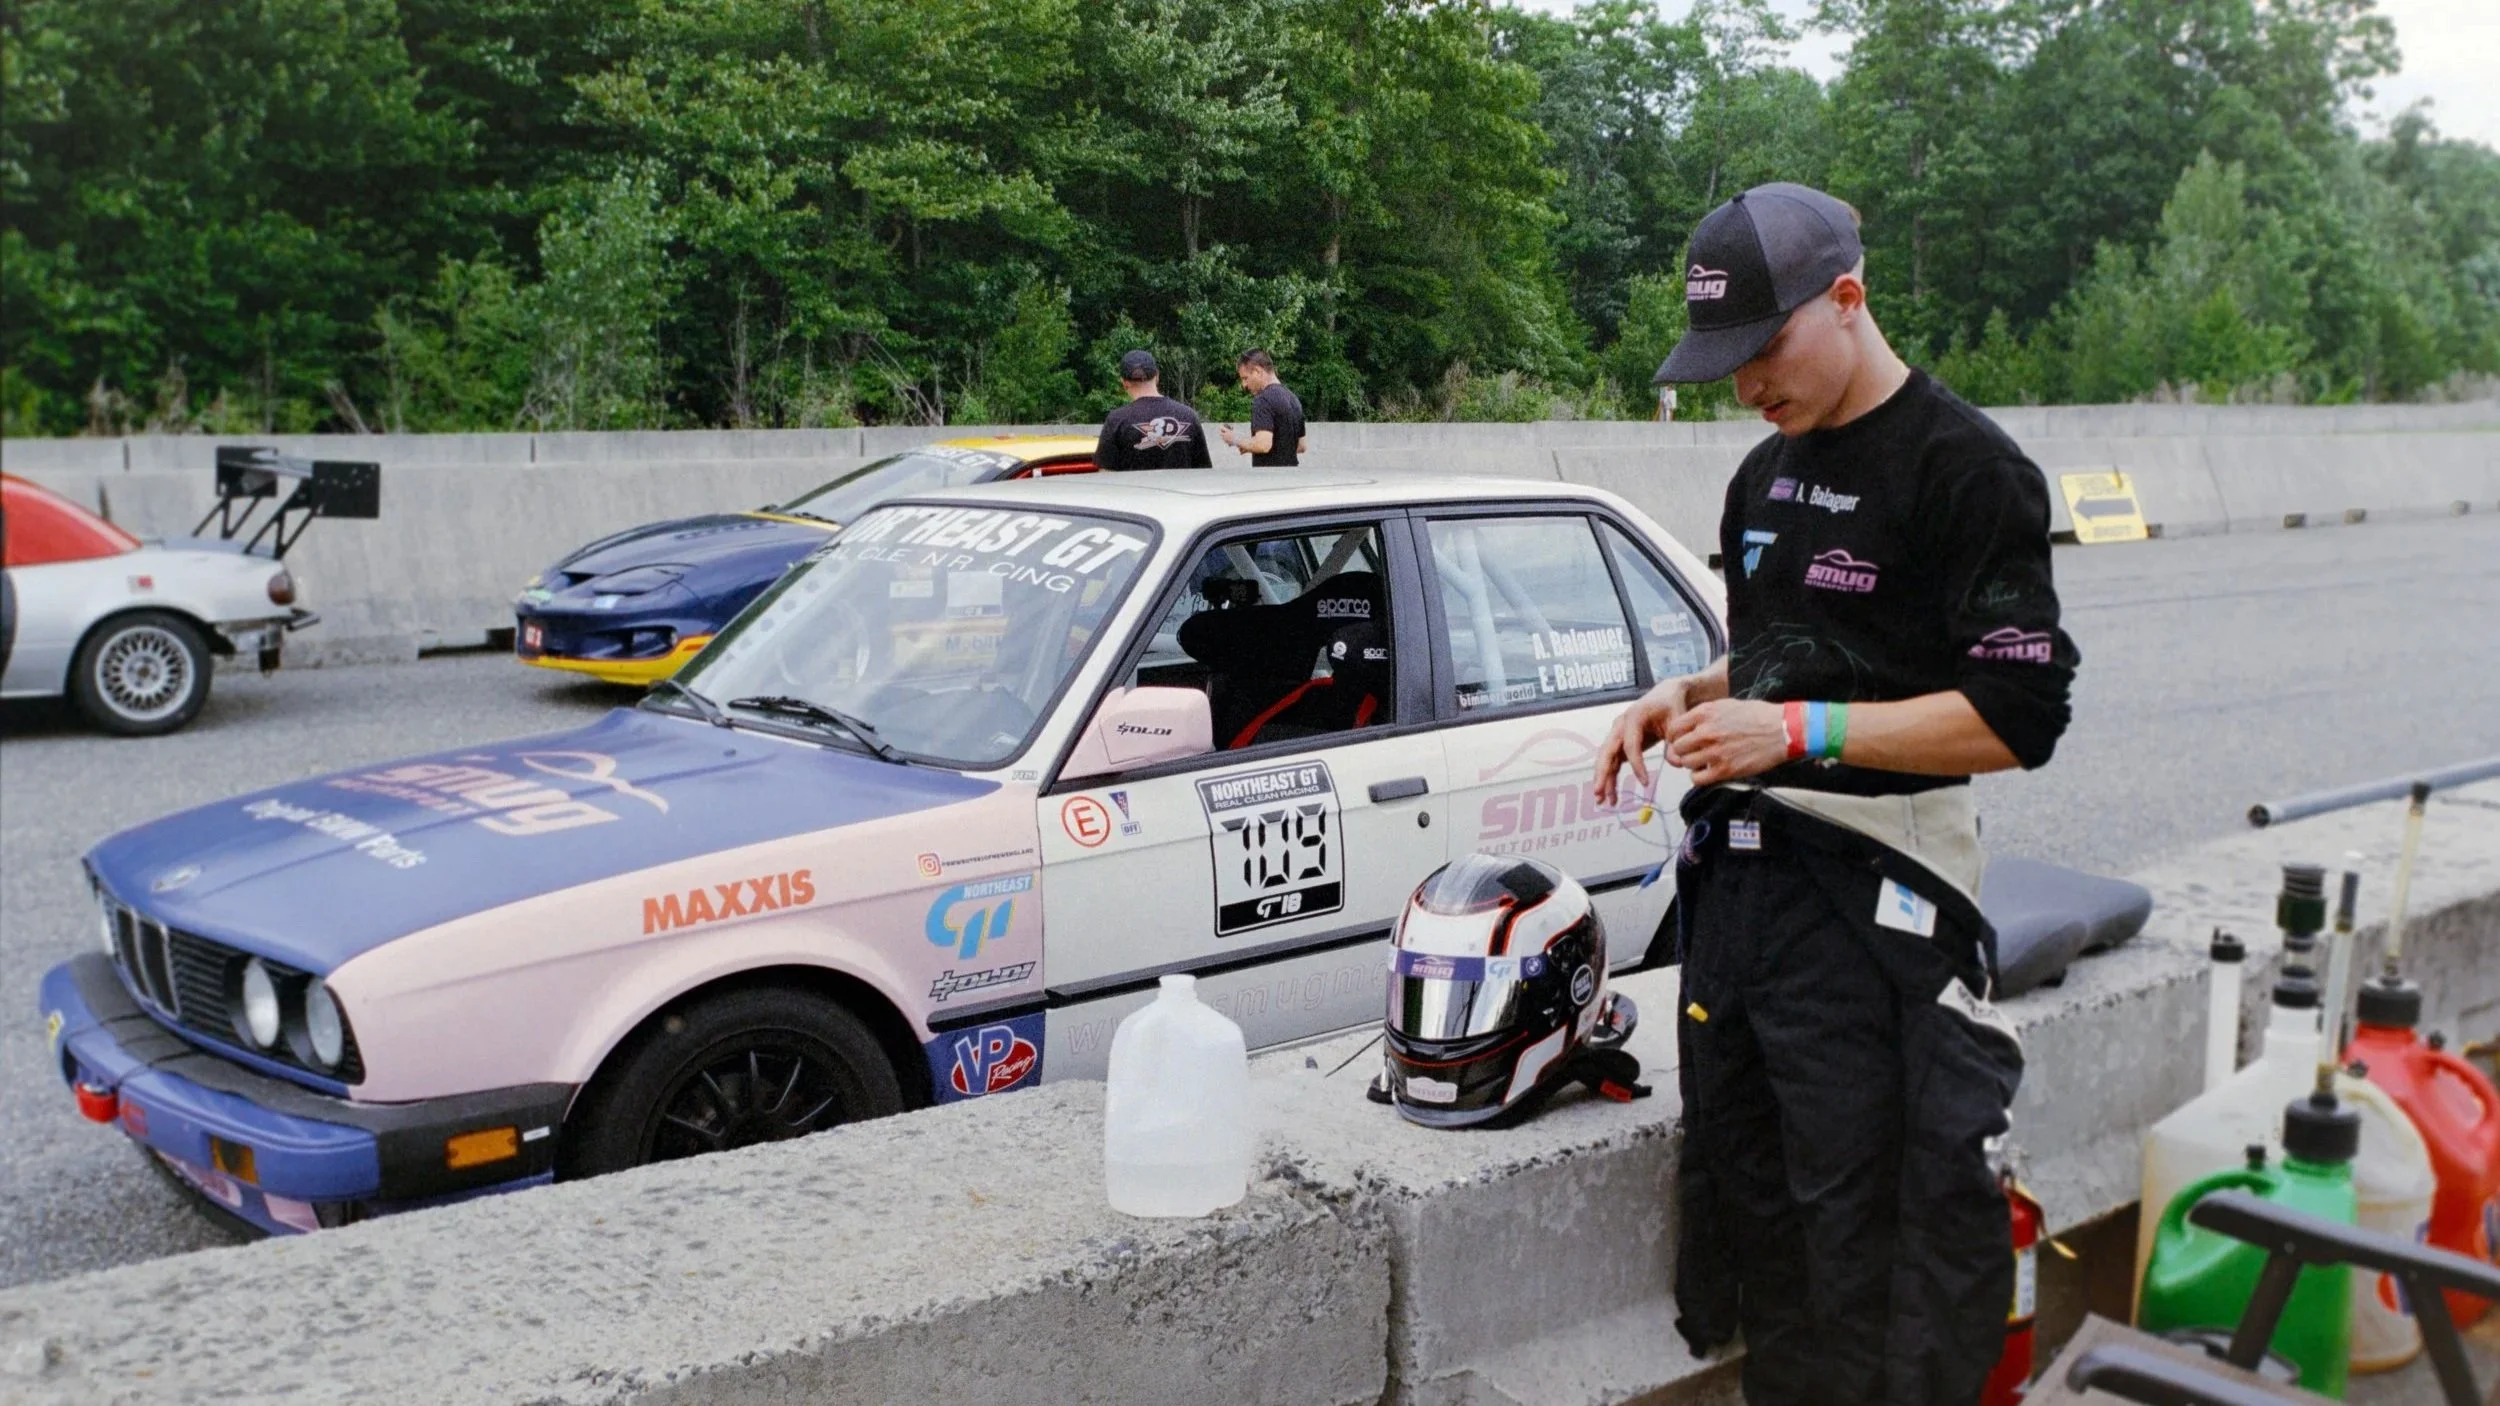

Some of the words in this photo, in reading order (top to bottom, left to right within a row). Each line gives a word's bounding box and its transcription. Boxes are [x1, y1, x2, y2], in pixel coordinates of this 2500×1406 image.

[1149, 417, 1181, 438] 3D
[1809, 485, 1860, 513] Balaguer
[1042, 527, 1148, 574] GT
[1805, 564, 1877, 592] smug
[1317, 599, 1370, 619] sparco
[1364, 648, 1388, 659] spar
[1532, 633, 1549, 660] A.
[1551, 627, 1626, 657] Balaguer
[1556, 659, 1629, 691] Balaguer
[1211, 773, 1296, 802] NORTHEAST
[1300, 768, 1318, 786] GT
[1215, 799, 1243, 809] REAL
[1245, 793, 1279, 804] CLEAN
[1280, 786, 1320, 797] RACING
[1072, 805, 1101, 837] E
[643, 869, 815, 935] MAXXIS
[963, 875, 1033, 900] NORTHEAST
[955, 1025, 1015, 1095] VP
[991, 1055, 1036, 1087] Racing
